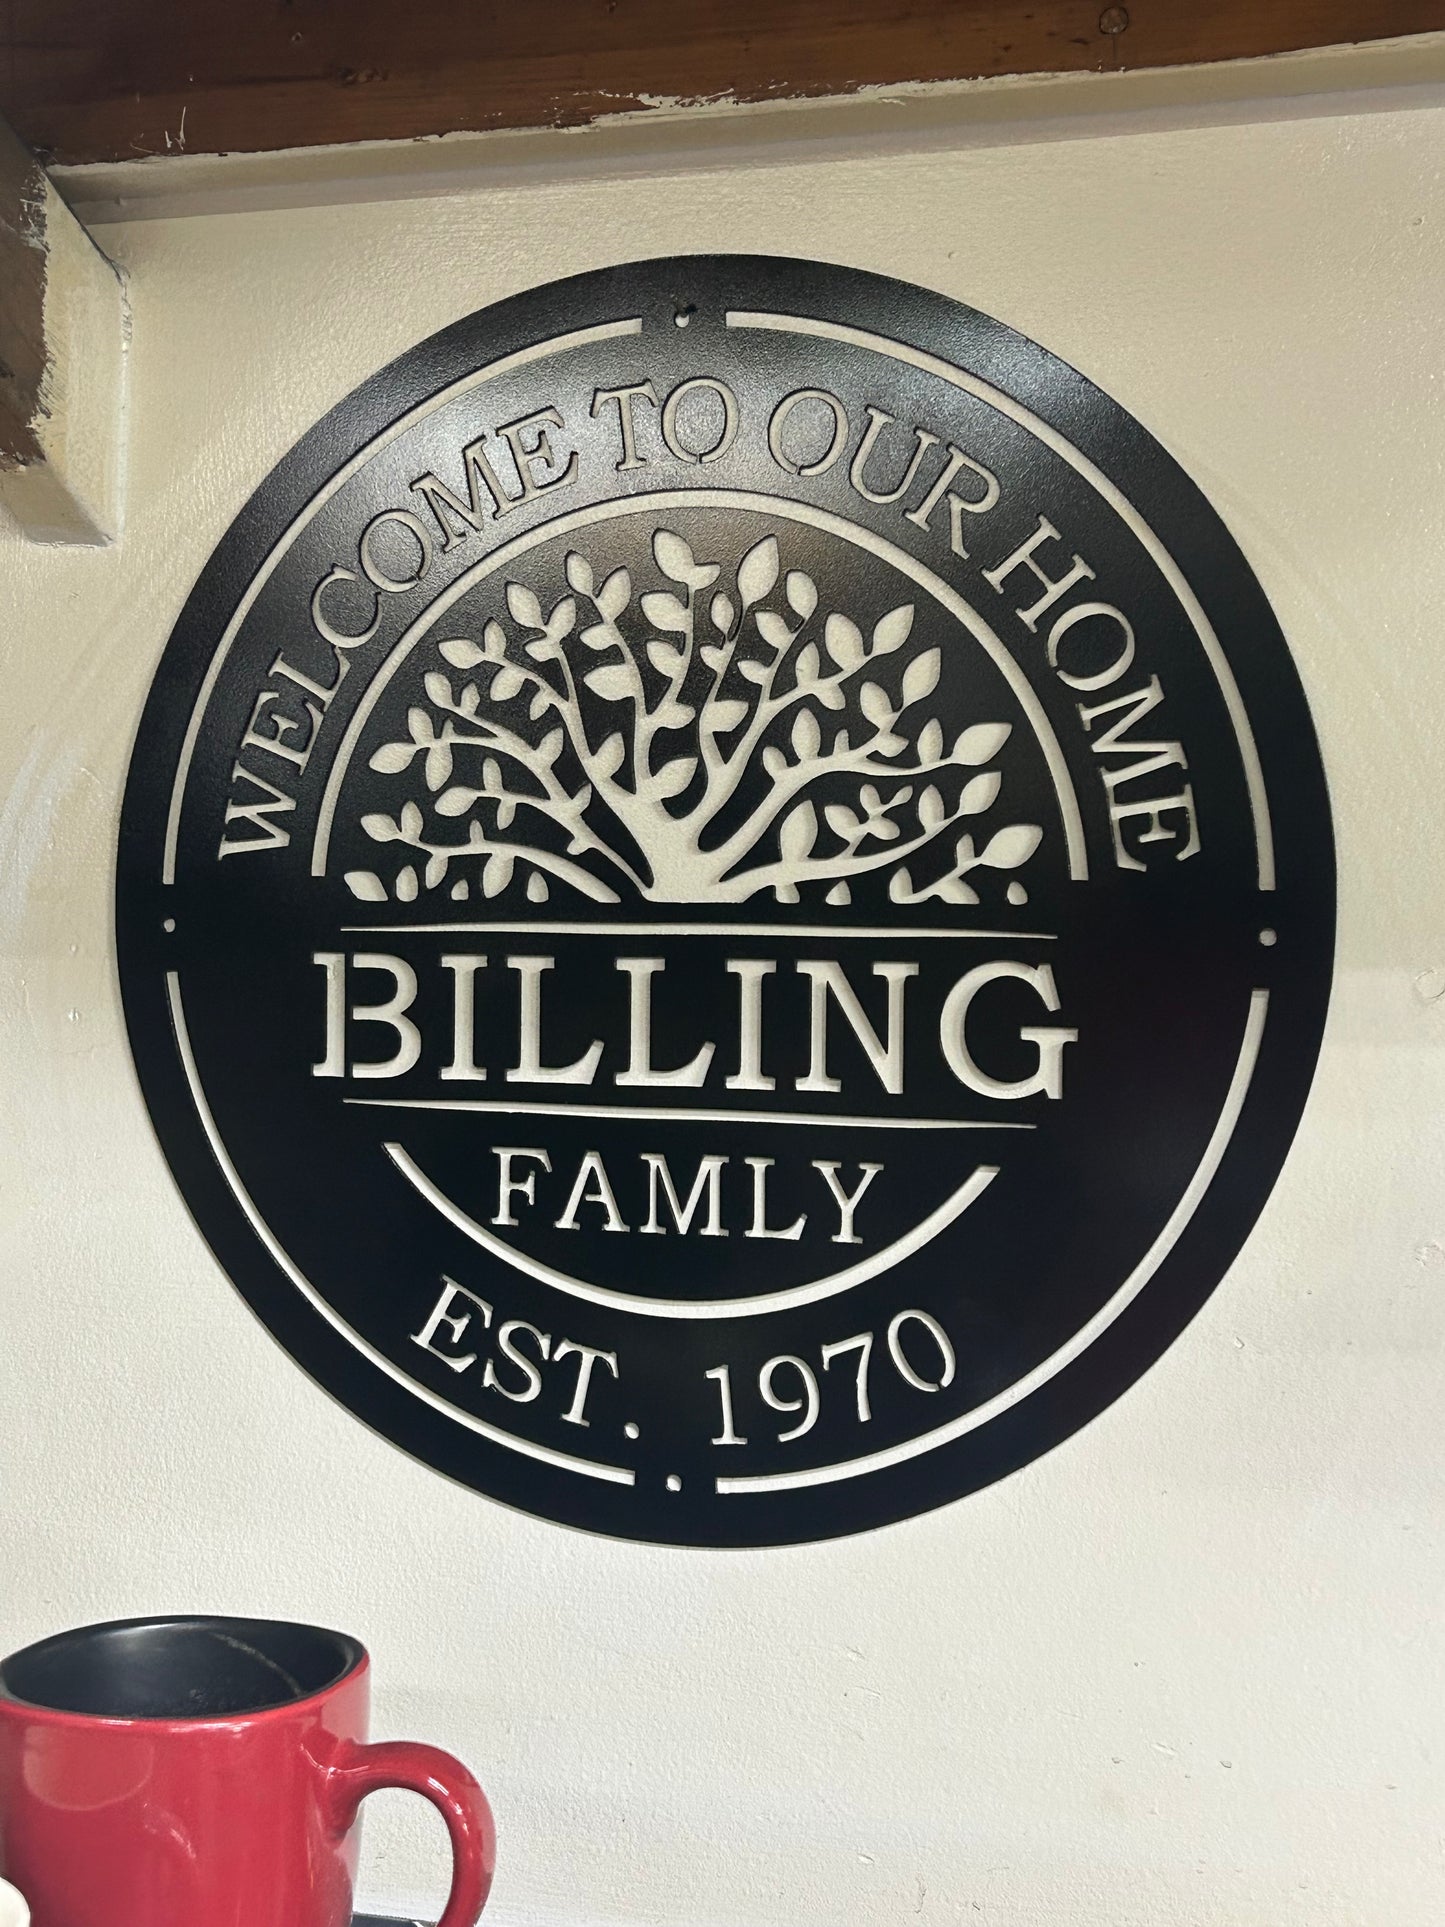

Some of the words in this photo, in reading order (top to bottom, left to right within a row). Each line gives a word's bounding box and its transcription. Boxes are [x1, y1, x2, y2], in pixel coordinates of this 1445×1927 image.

[218, 406, 579, 860] WELCOME
[589, 376, 740, 472] TO
[768, 387, 1000, 560] OUR
[981, 514, 1201, 872] HOME
[311, 953, 1079, 1100] BILLING
[489, 1146, 884, 1244] FAMLY
[410, 1275, 641, 1440] EST.
[705, 1308, 957, 1446] 1970
